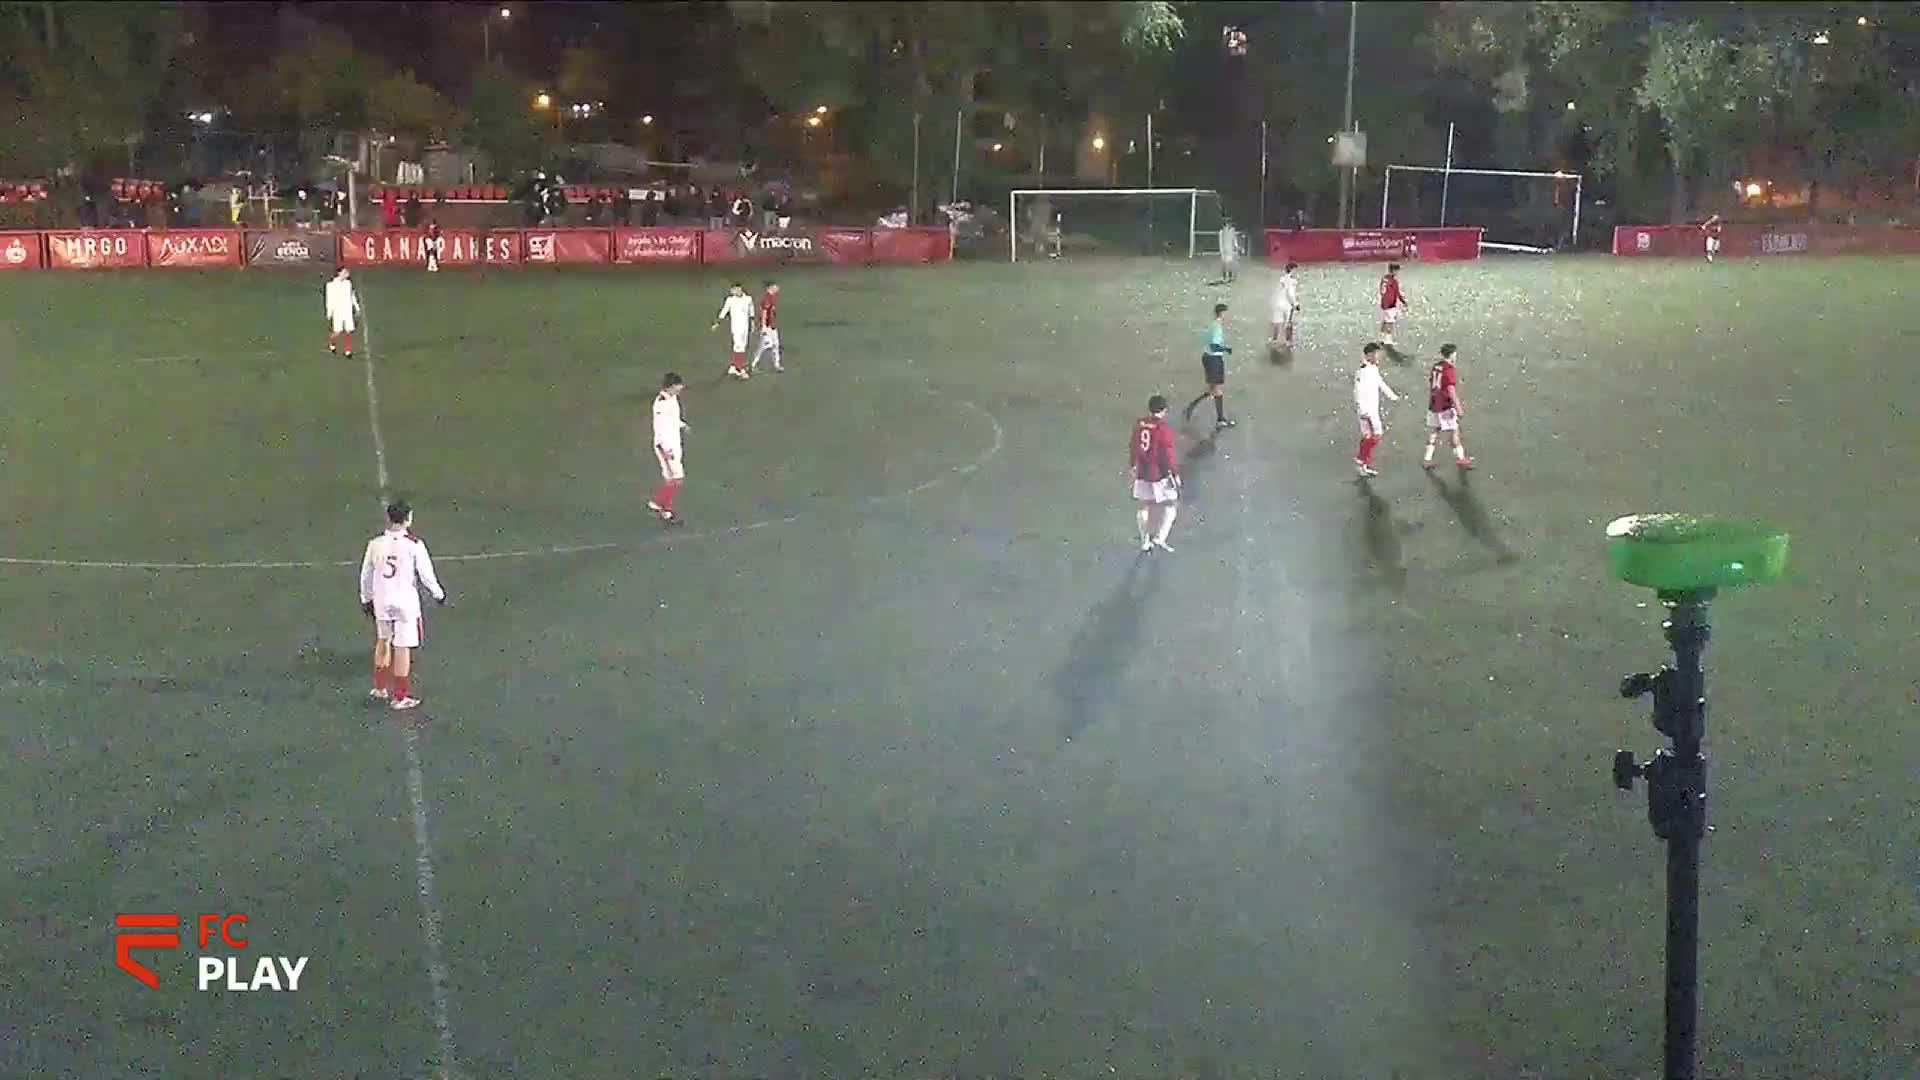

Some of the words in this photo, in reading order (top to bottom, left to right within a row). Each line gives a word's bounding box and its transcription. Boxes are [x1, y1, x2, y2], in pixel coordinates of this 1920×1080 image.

[67, 237, 127, 257] MRGO
[760, 236, 812, 250] macron
[1140, 429, 1151, 452] 9
[382, 555, 397, 578] 5
